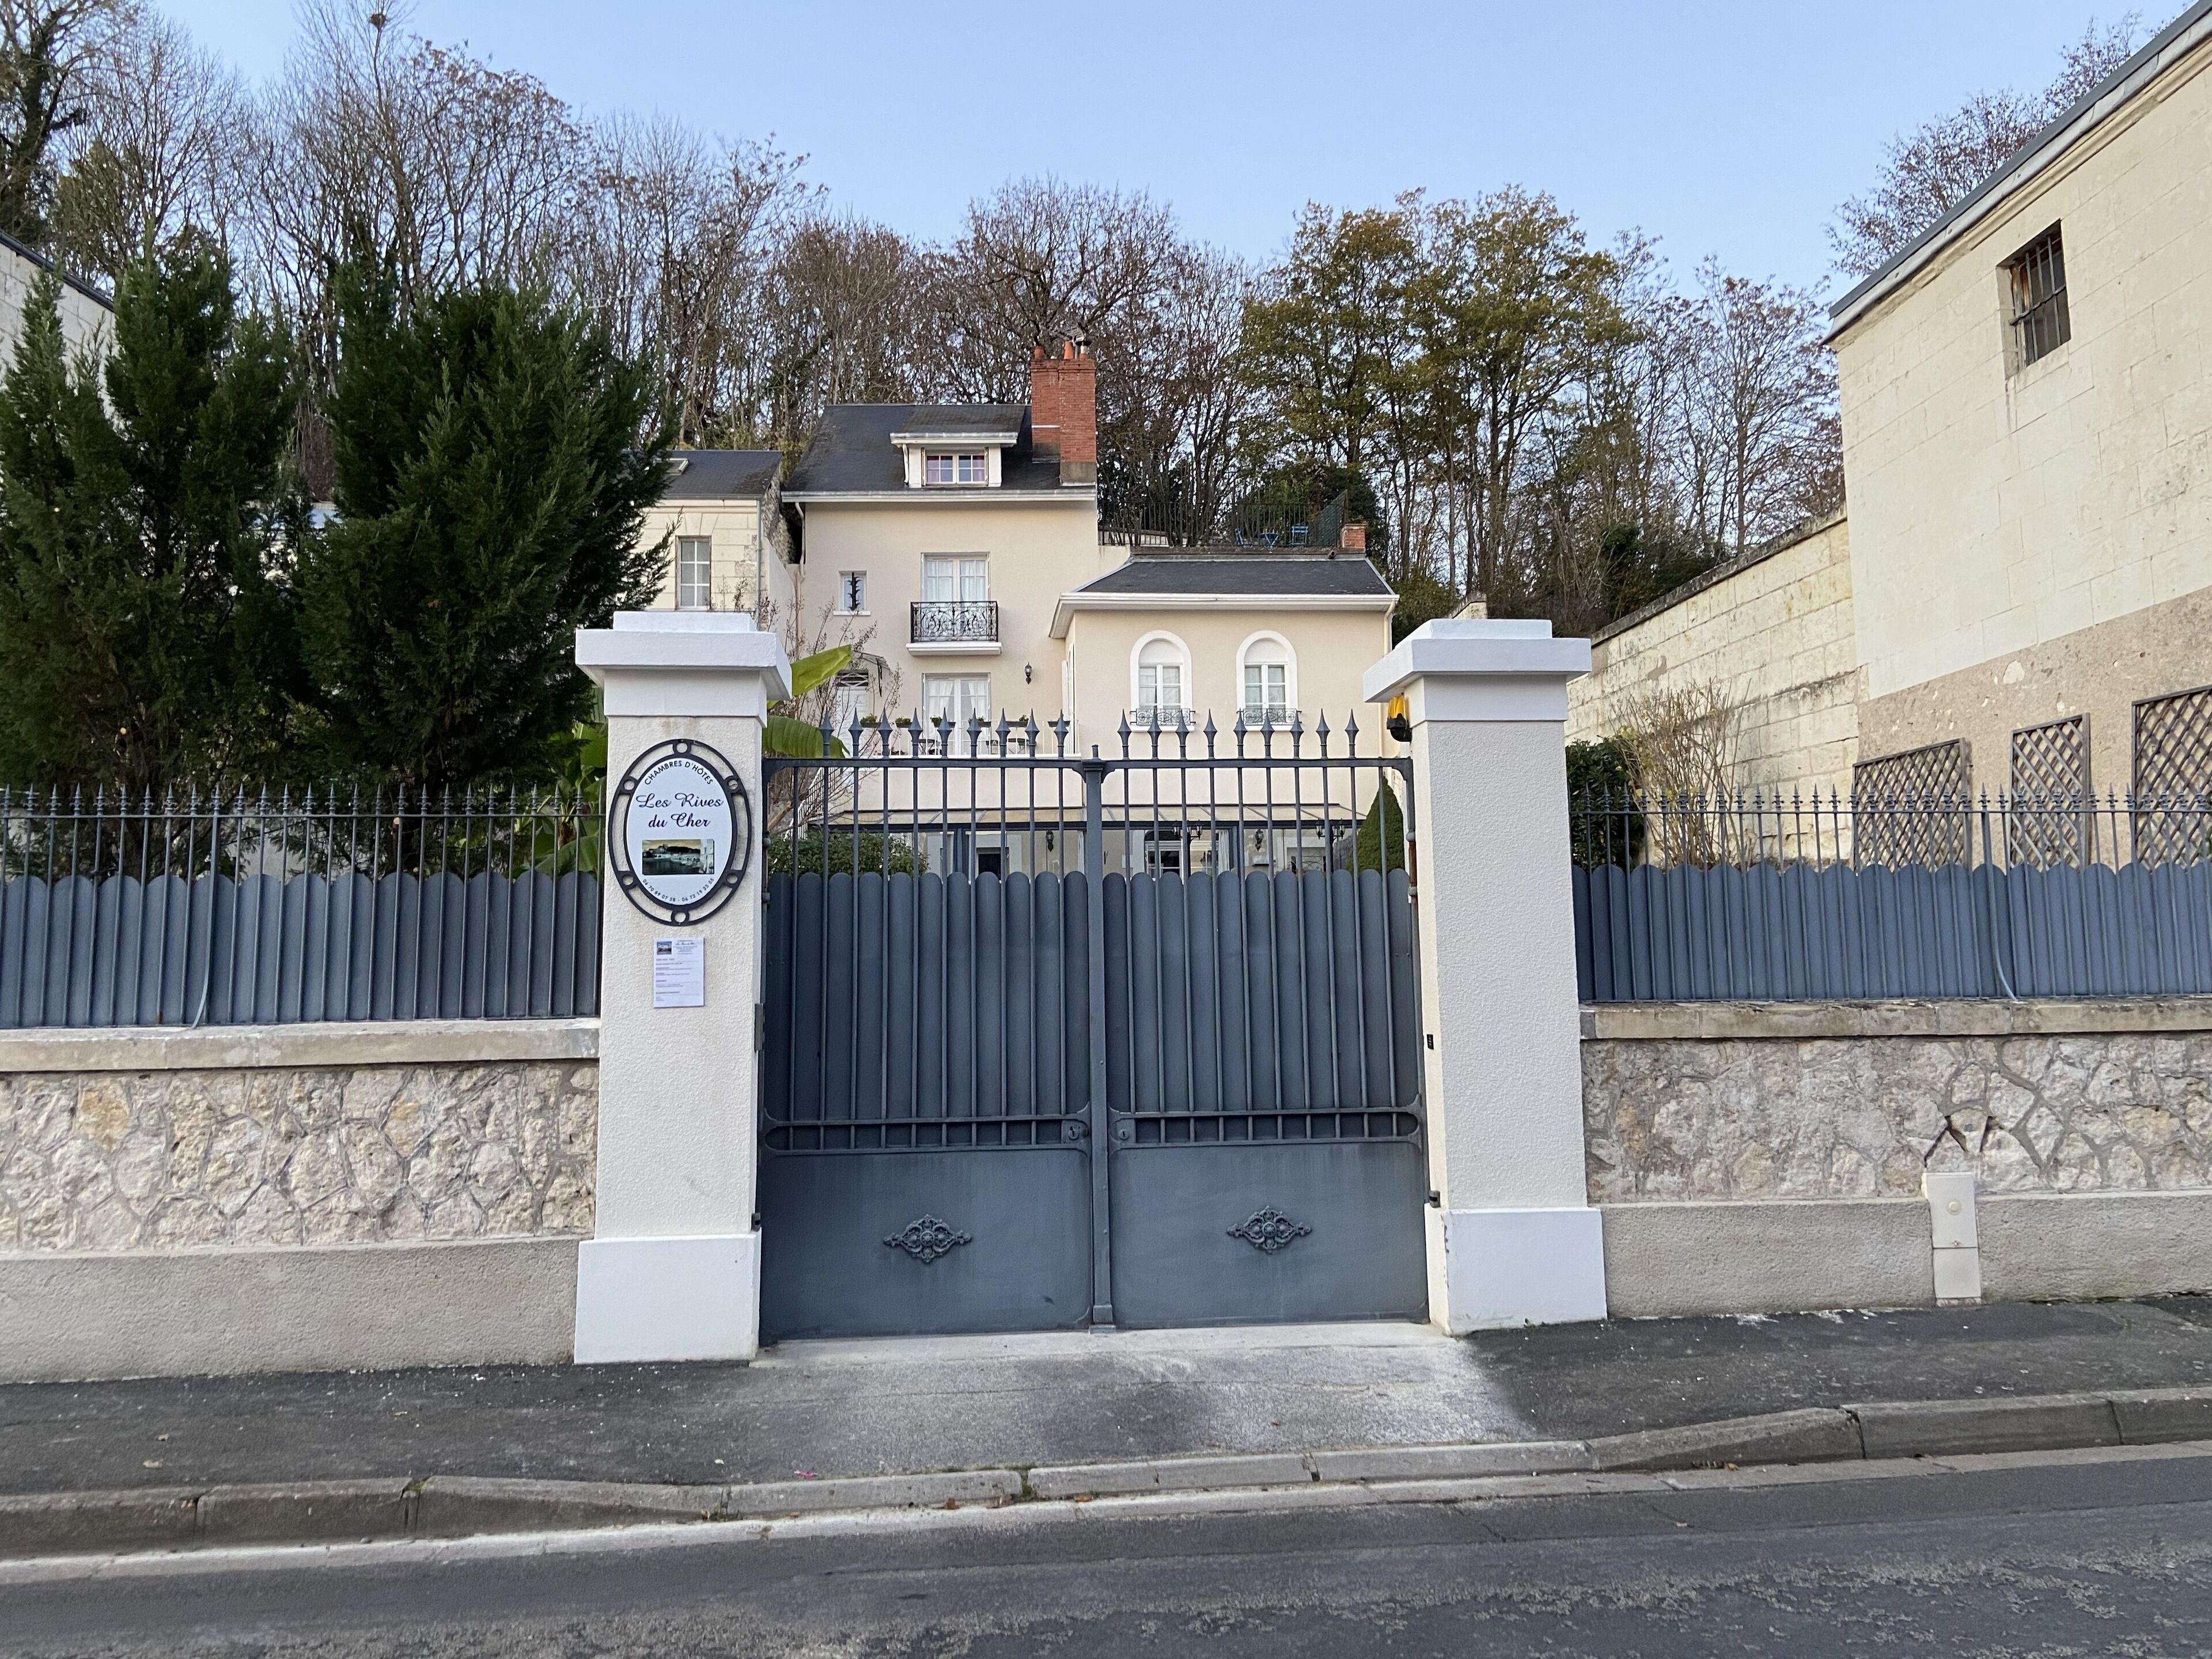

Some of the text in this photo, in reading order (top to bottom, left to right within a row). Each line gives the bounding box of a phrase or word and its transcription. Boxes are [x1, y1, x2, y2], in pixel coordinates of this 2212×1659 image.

[645, 760, 713, 785] CHAMBRES D'HÔTES
[636, 793, 724, 808] Les Rives
[648, 812, 711, 827] du Cher
